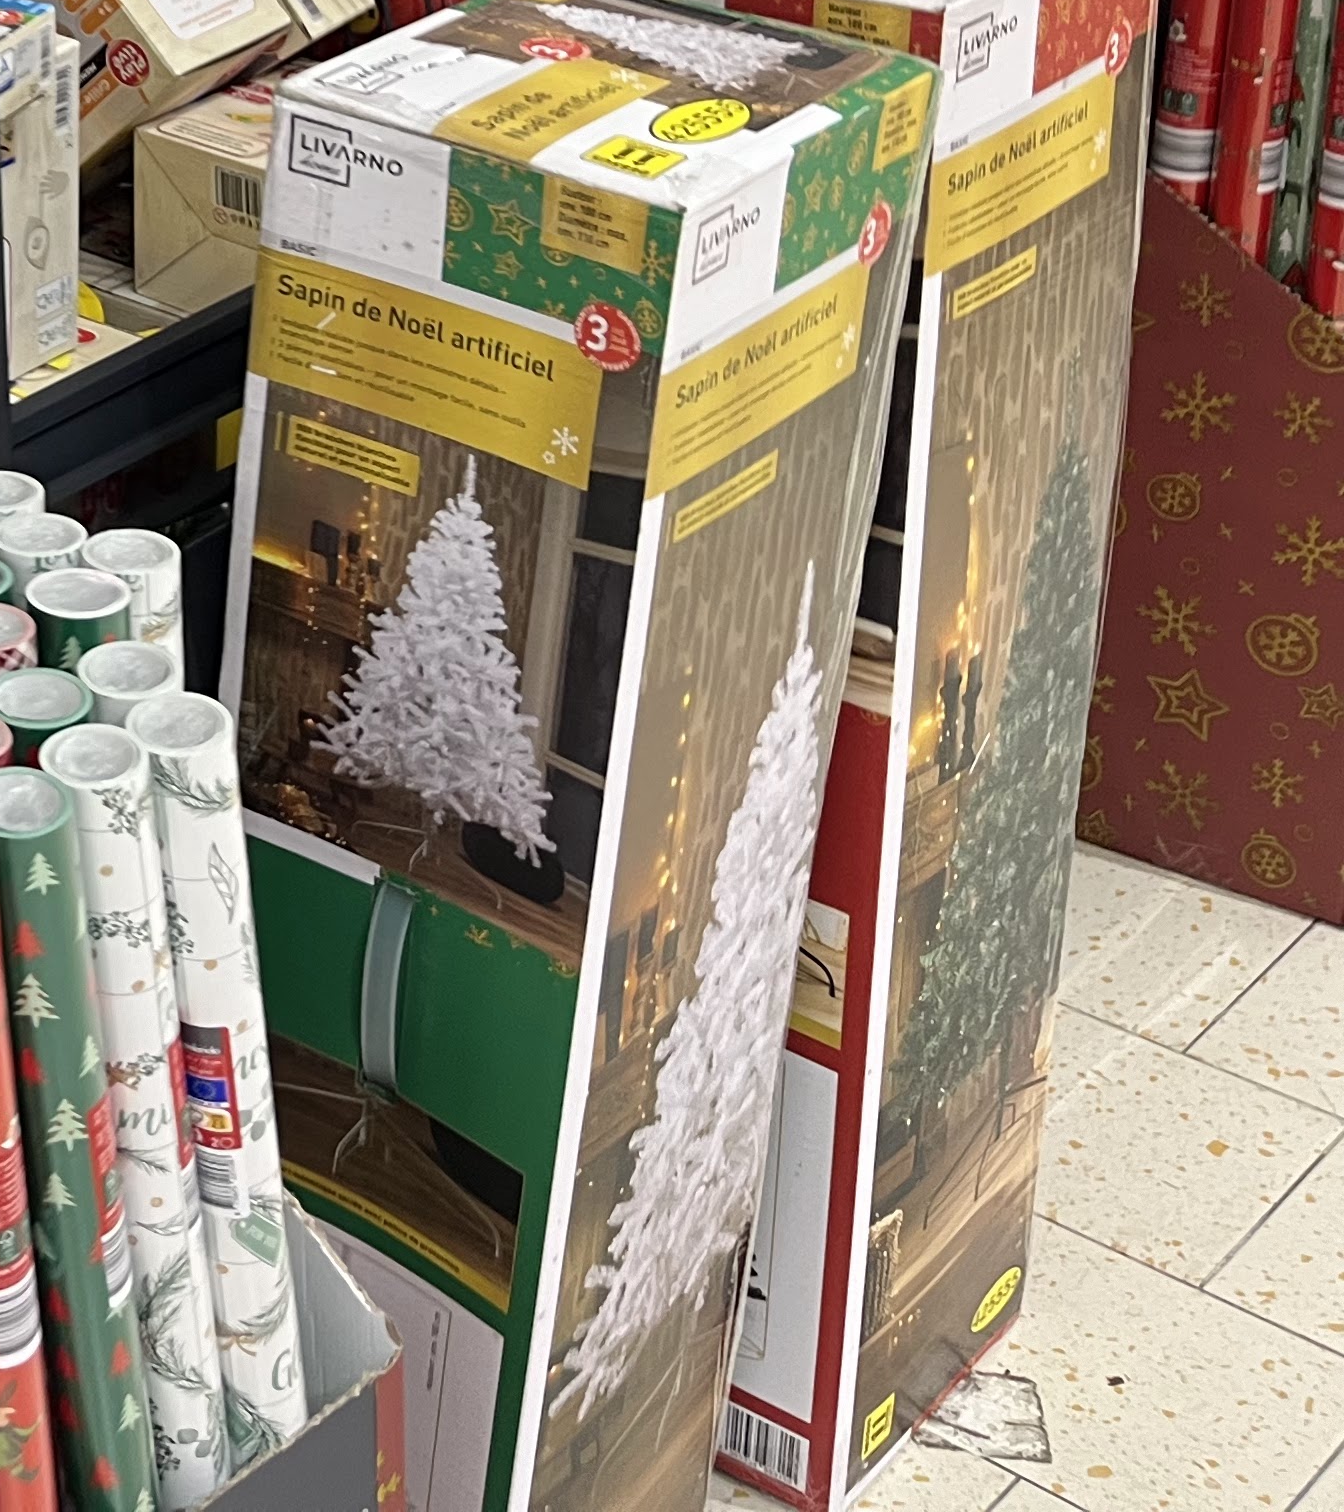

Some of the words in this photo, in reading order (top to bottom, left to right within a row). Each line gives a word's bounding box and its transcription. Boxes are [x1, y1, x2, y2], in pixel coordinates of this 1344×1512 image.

[962, 14, 1019, 56] LIVARNO
[1107, 37, 1120, 66] 3
[297, 129, 404, 180] LIVARNO
[946, 155, 987, 196] Sapin
[988, 148, 1007, 173] de
[1008, 131, 1040, 164] Noël
[1039, 101, 1090, 153] artificiel
[278, 237, 318, 259] BASIC
[700, 206, 761, 257] LIVARNO
[862, 218, 880, 257] 3
[276, 272, 347, 313] Sapin
[351, 295, 382, 323] de
[388, 304, 444, 345] Noël
[450, 329, 555, 383] artificiel
[584, 312, 610, 353] 3
[673, 370, 720, 410] Sapin
[721, 356, 742, 378] de
[743, 337, 779, 373] Noël
[778, 292, 840, 347] artificiel
